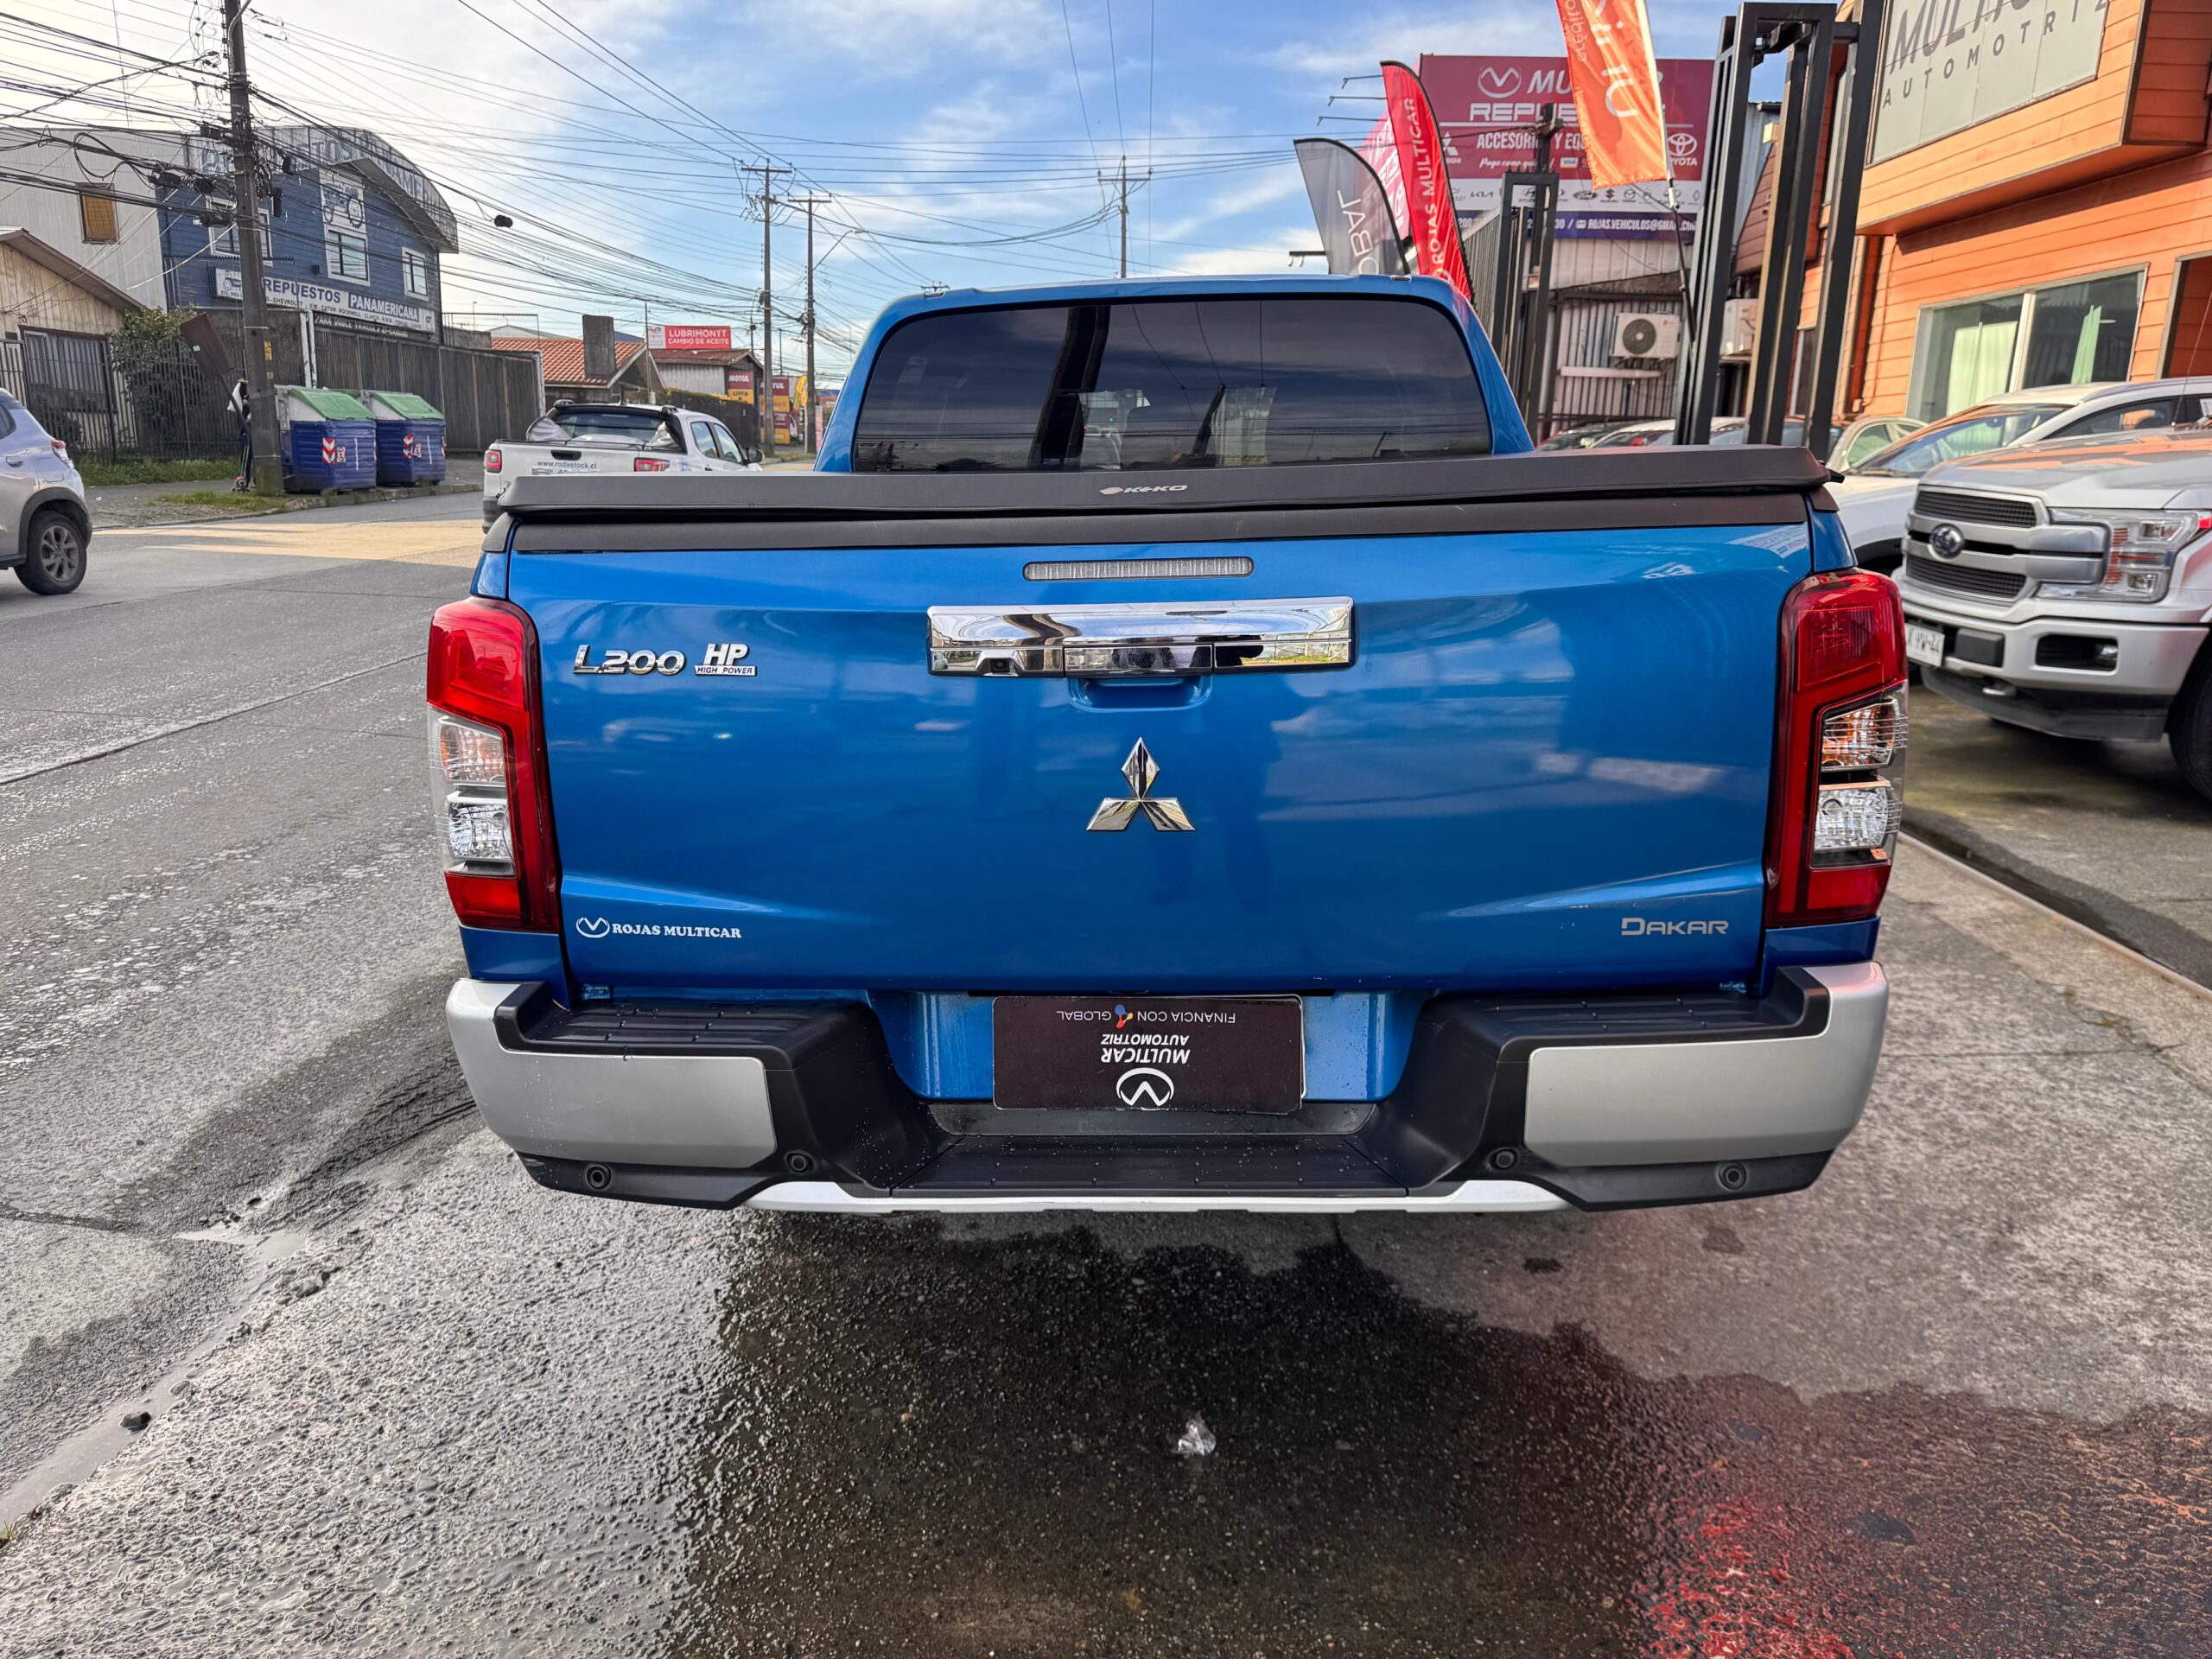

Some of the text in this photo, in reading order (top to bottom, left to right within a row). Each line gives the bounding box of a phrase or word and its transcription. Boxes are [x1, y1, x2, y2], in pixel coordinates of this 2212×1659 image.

[1403, 98, 1444, 267] ROJAS MULTICAR
[264, 278, 419, 321] REPUESTOS PANAMERICANA
[669, 328, 728, 338] LUBRIMONTT
[728, 374, 750, 383] MOTUL
[537, 461, 597, 470] www.rodastock.cl
[573, 643, 750, 676] L200 HP
[612, 923, 742, 938] ROJAS MULTICAR
[1056, 1010, 1236, 1024] FINANCIA CON GLOBAL
[1100, 1033, 1190, 1046] AUTOMOTRIZ
[1100, 1048, 1191, 1064] MULTICAR
